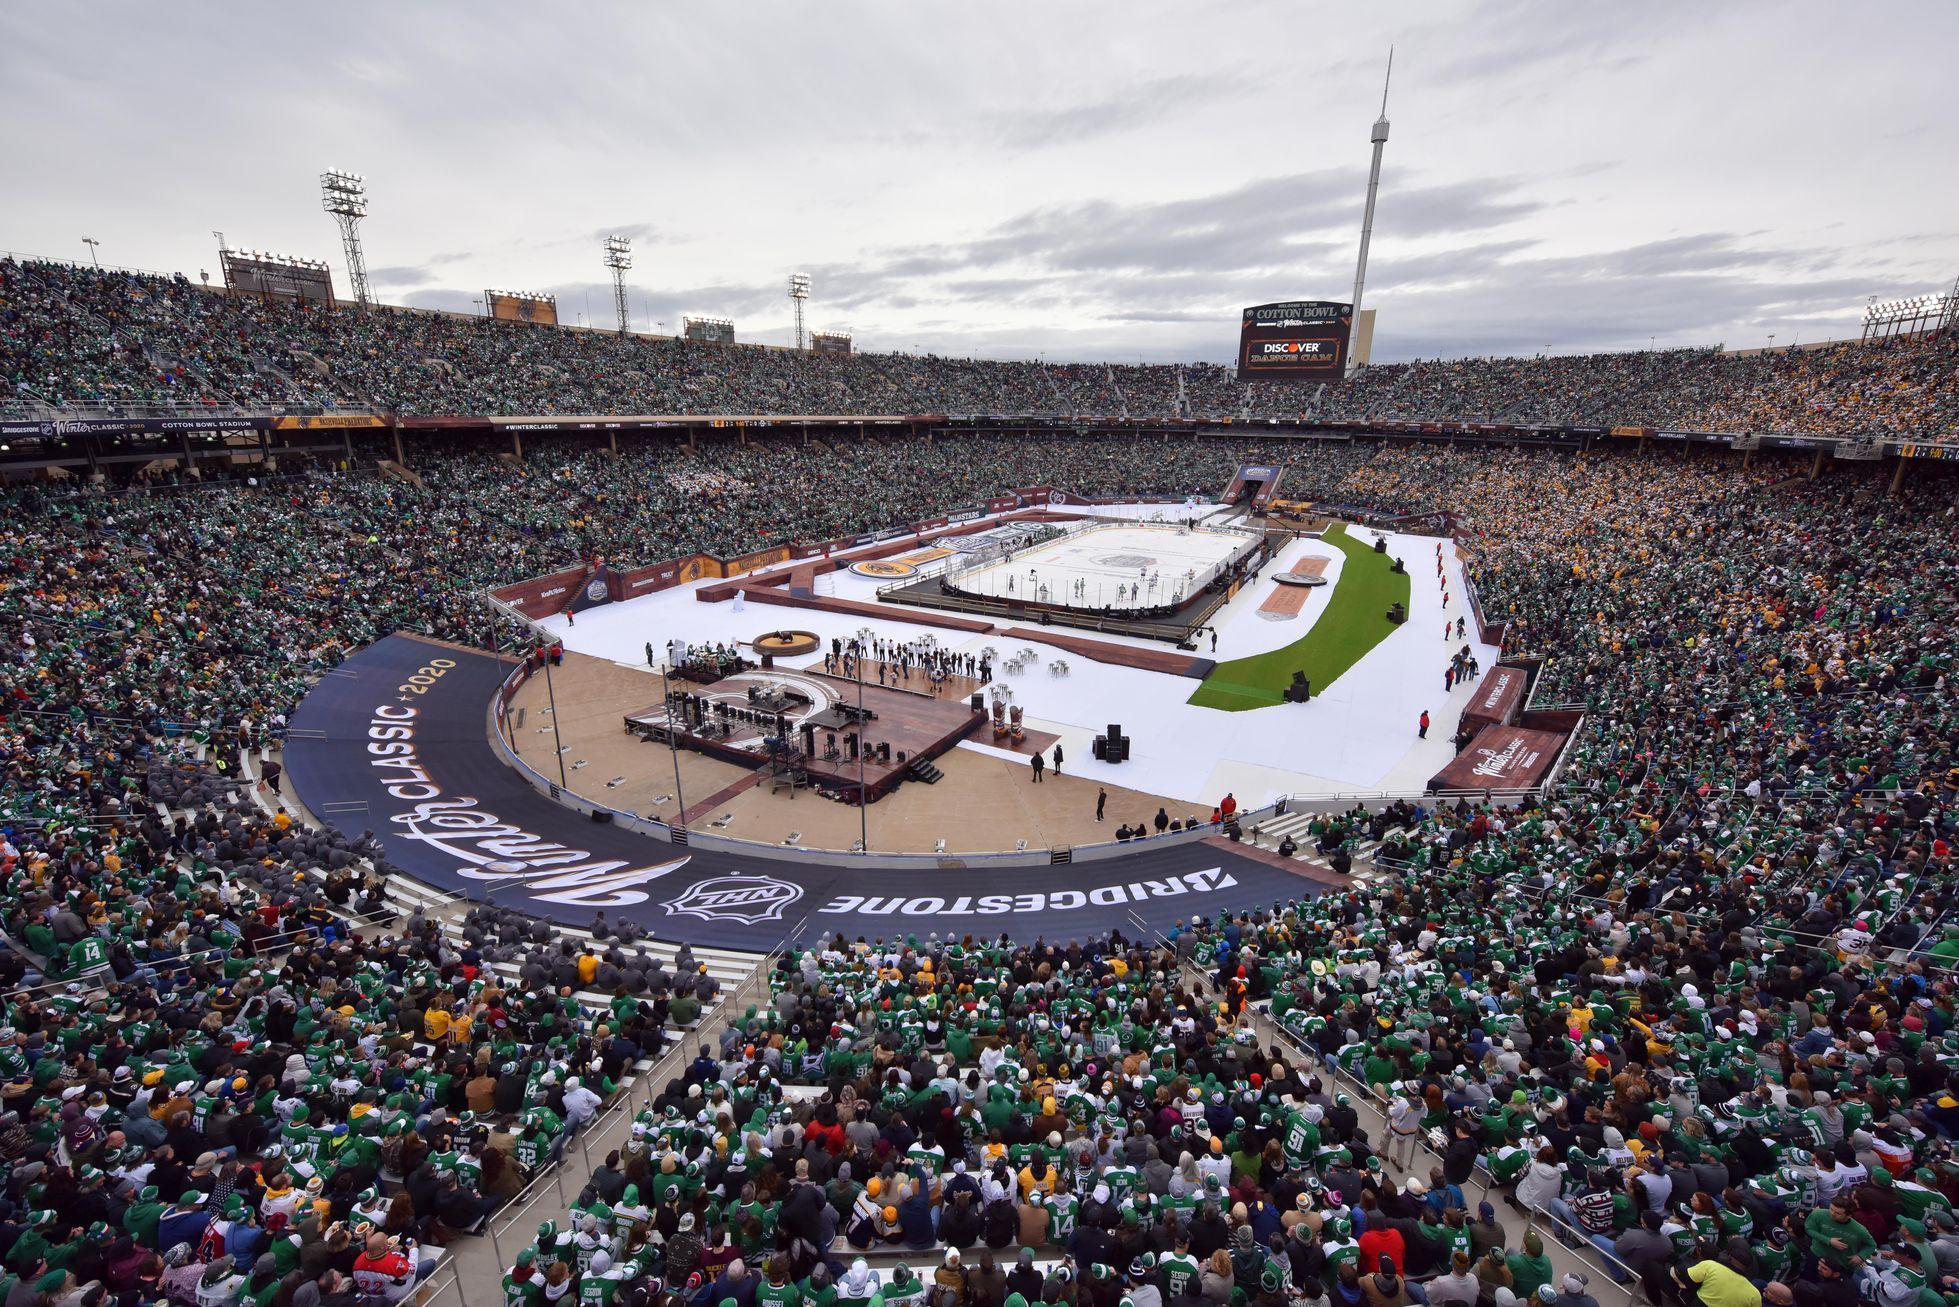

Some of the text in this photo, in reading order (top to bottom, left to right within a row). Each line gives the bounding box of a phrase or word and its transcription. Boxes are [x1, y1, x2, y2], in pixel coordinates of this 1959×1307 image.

[250, 268, 282, 282] Winter
[1256, 307, 1337, 319] COTTON BOWL
[1264, 343, 1319, 353] DISCOVER
[1250, 354, 1298, 362] DANCE
[2, 426, 39, 434] BRIDGESTONE
[52, 420, 92, 436] Winter
[962, 510, 980, 520] STARS
[660, 570, 674, 578] TRULY
[1472, 751, 1508, 778] Winter
[1502, 738, 1524, 759] CLASSIC
[367, 658, 692, 907] Winter CLASSIC 2020
[697, 888, 781, 906] NHL
[817, 866, 1240, 915] BRIDGESTONE
[84, 946, 100, 962] 14
[782, 1062, 792, 1076] 91
[524, 1082, 538, 1098] 14
[192, 1115, 204, 1133] 91
[1287, 1129, 1304, 1153] 91
[518, 1148, 536, 1164] 32
[1112, 1186, 1134, 1202] 14
[1052, 1214, 1074, 1238] 14
[584, 1288, 602, 1296] SEGUIN
